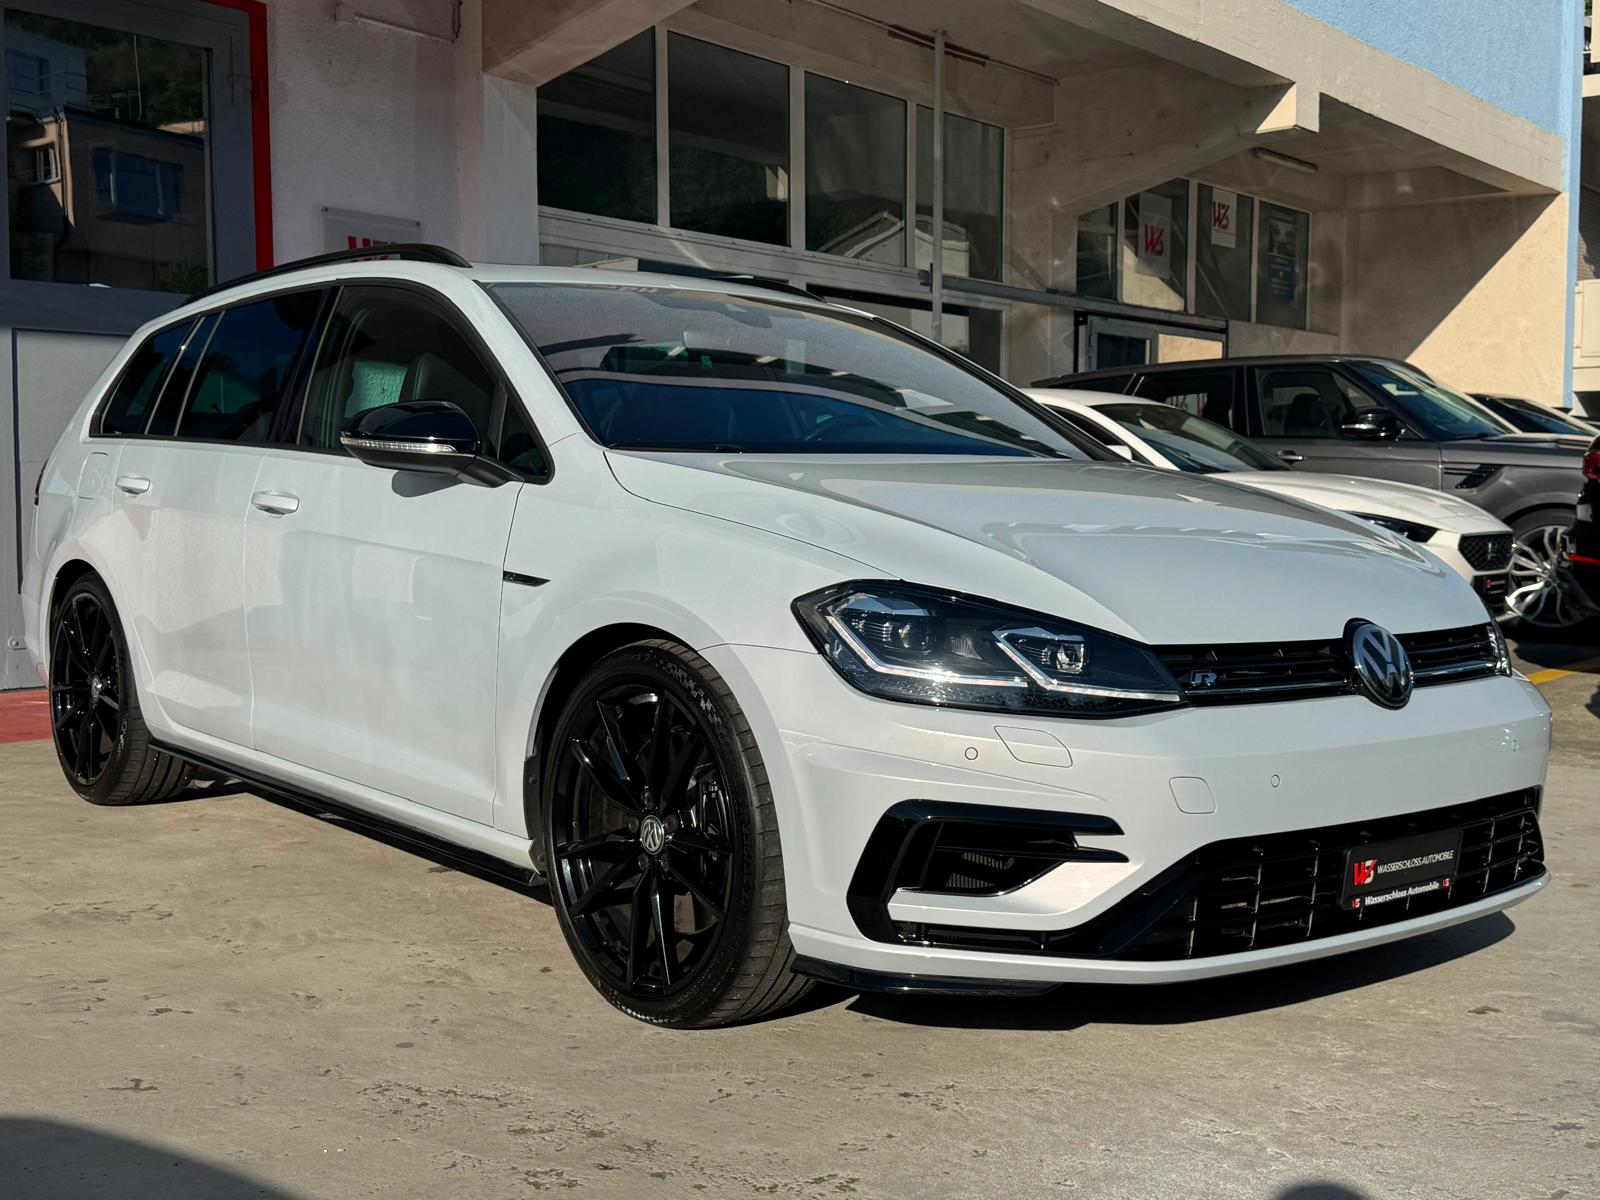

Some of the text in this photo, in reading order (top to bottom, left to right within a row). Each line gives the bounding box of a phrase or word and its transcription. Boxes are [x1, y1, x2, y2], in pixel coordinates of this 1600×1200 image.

[1191, 670, 1217, 687] R
[1377, 857, 1421, 874] WASSERSCHLOSS
[1364, 890, 1407, 906] Wasserschloss
[1407, 880, 1440, 896] Automobile
